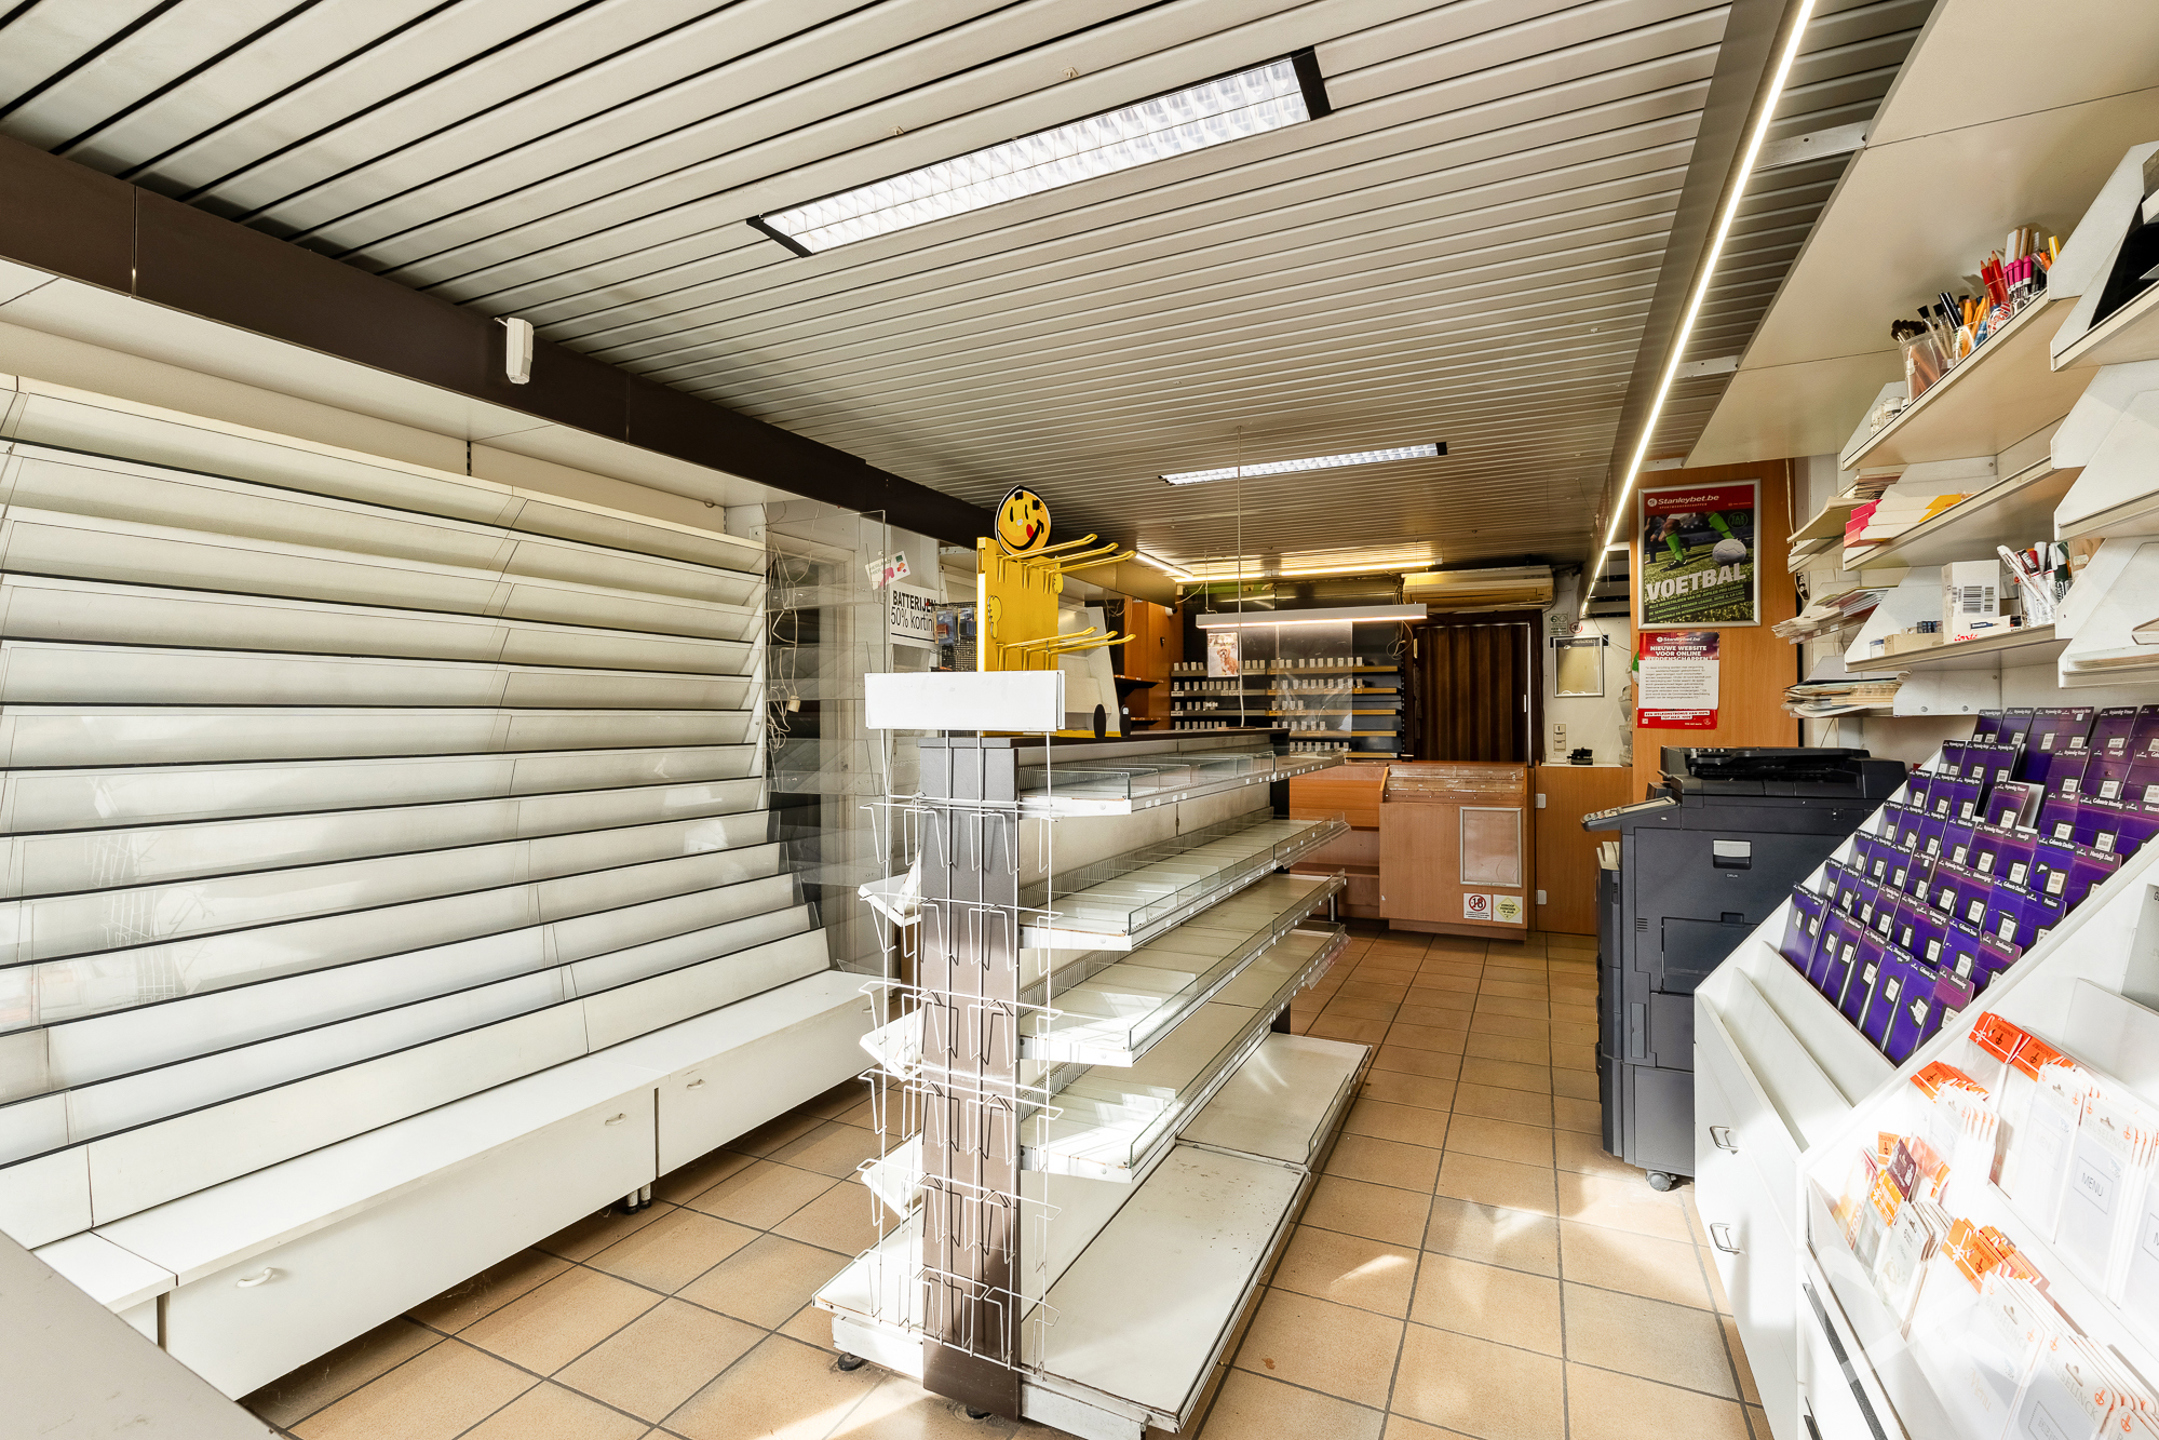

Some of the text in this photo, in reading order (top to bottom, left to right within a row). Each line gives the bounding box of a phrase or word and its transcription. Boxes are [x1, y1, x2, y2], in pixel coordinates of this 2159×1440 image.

[1658, 495, 1720, 505] Stanleybet.be
[1646, 563, 1746, 600] VOETBAL
[890, 606, 908, 628] 50%
[2081, 1172, 2104, 1197] MENU
[2045, 1351, 2098, 1422] BEUSELINCK
